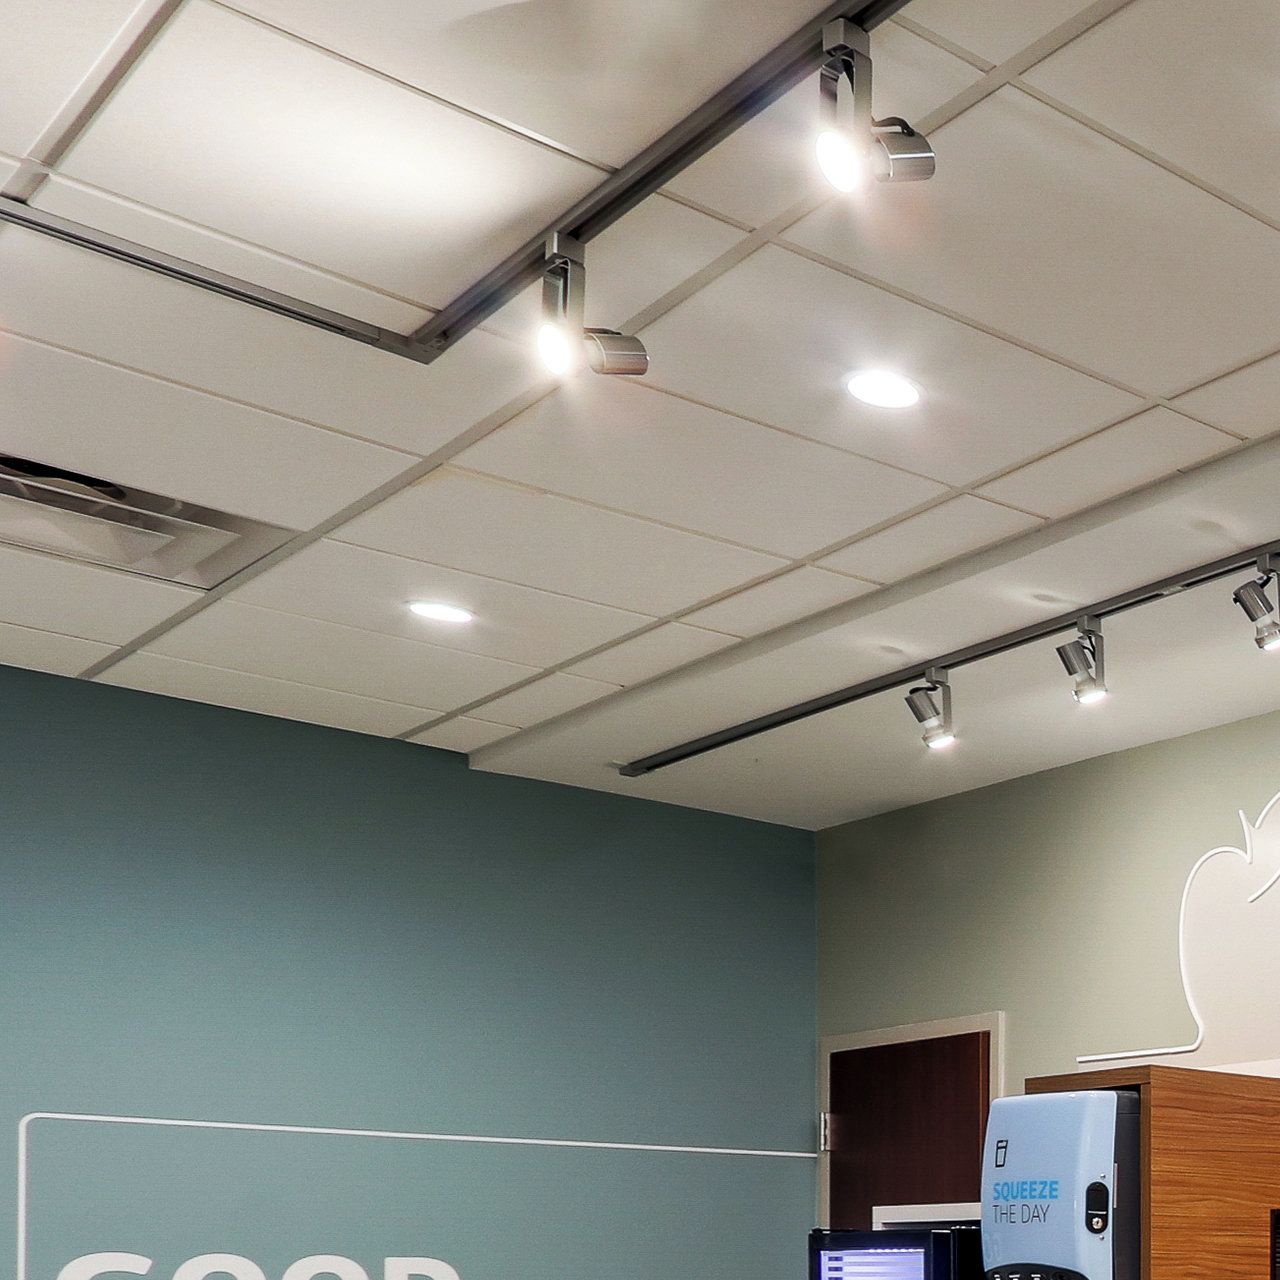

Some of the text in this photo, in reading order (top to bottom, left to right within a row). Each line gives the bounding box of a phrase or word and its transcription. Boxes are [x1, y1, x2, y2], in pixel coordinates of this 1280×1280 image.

[992, 1180, 1059, 1201] SQUEEZE
[992, 1204, 1050, 1223] THE DAY
